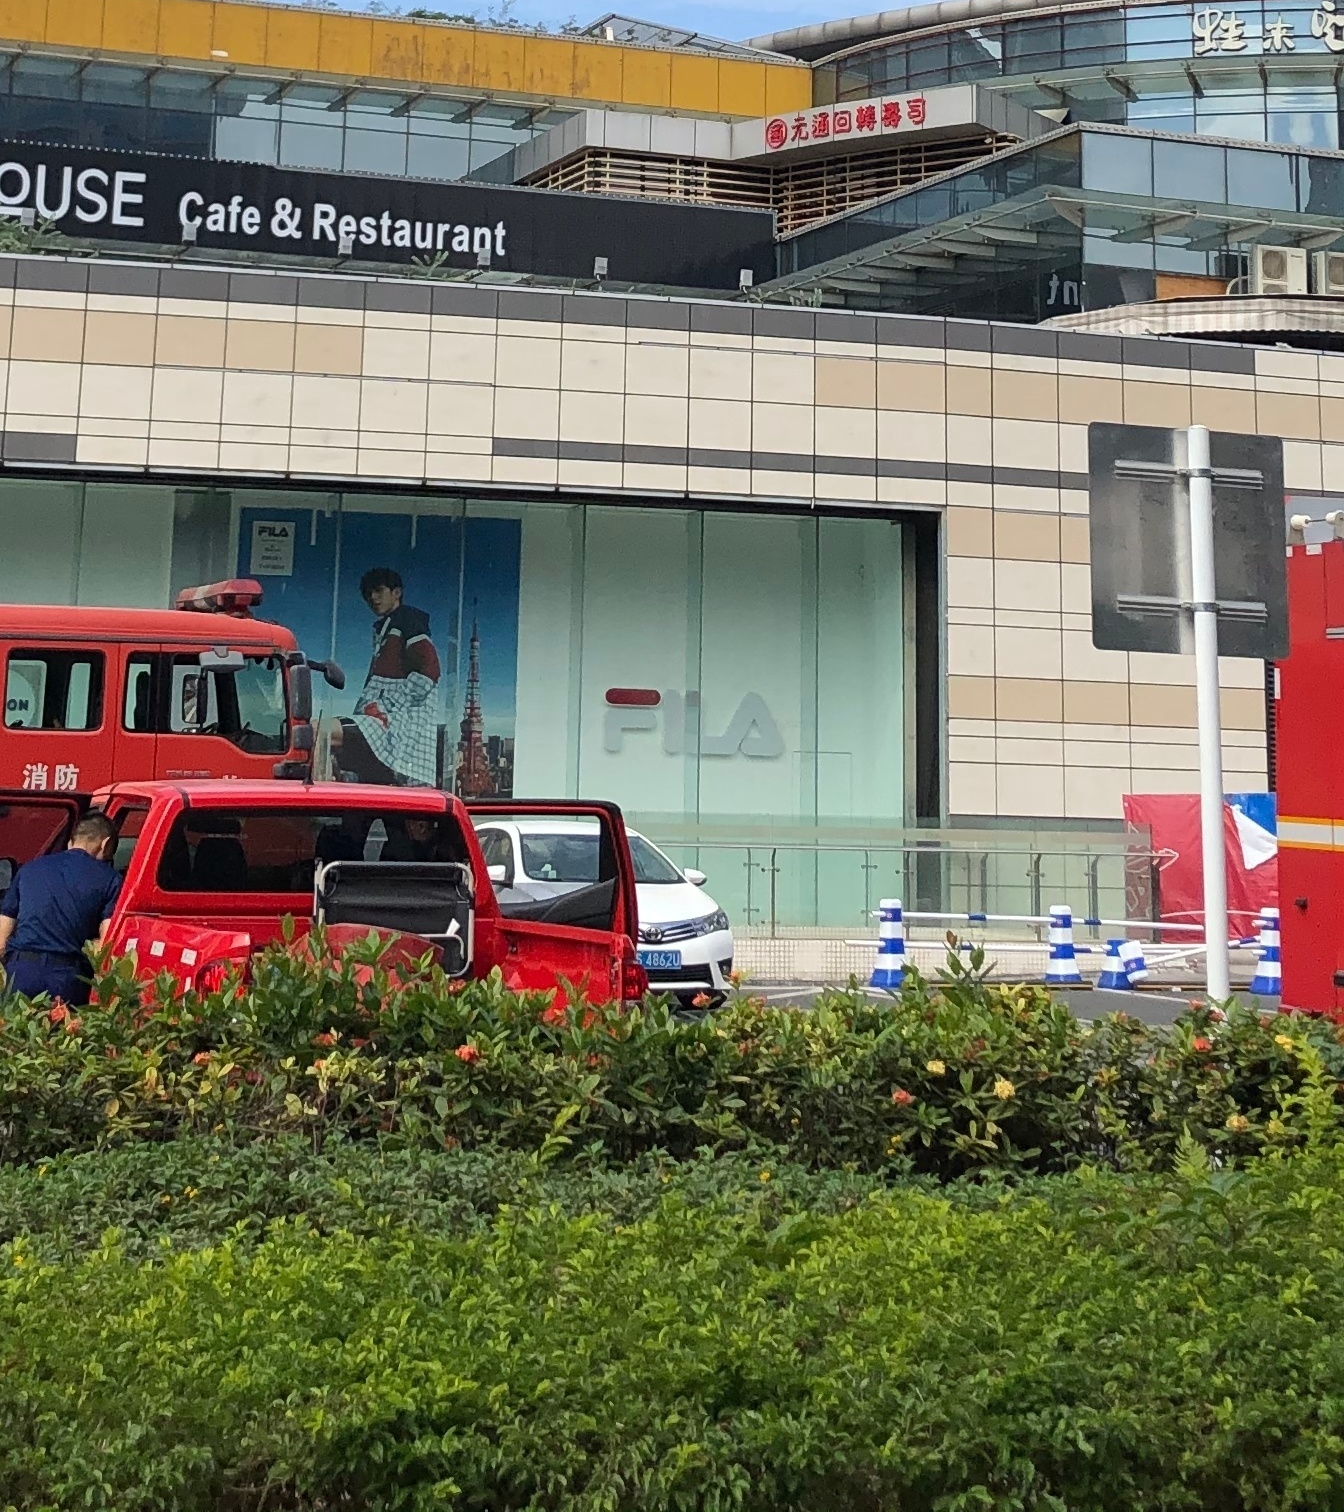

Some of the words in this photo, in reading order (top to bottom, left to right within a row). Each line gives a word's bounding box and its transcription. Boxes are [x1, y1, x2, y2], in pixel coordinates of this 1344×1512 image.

[179, 191, 261, 236] Cafe
[270, 197, 302, 240] &
[312, 202, 506, 256] Restaurant
[258, 526, 289, 537] FILA
[604, 688, 786, 758] FILA
[22, 762, 80, 791] 消防
